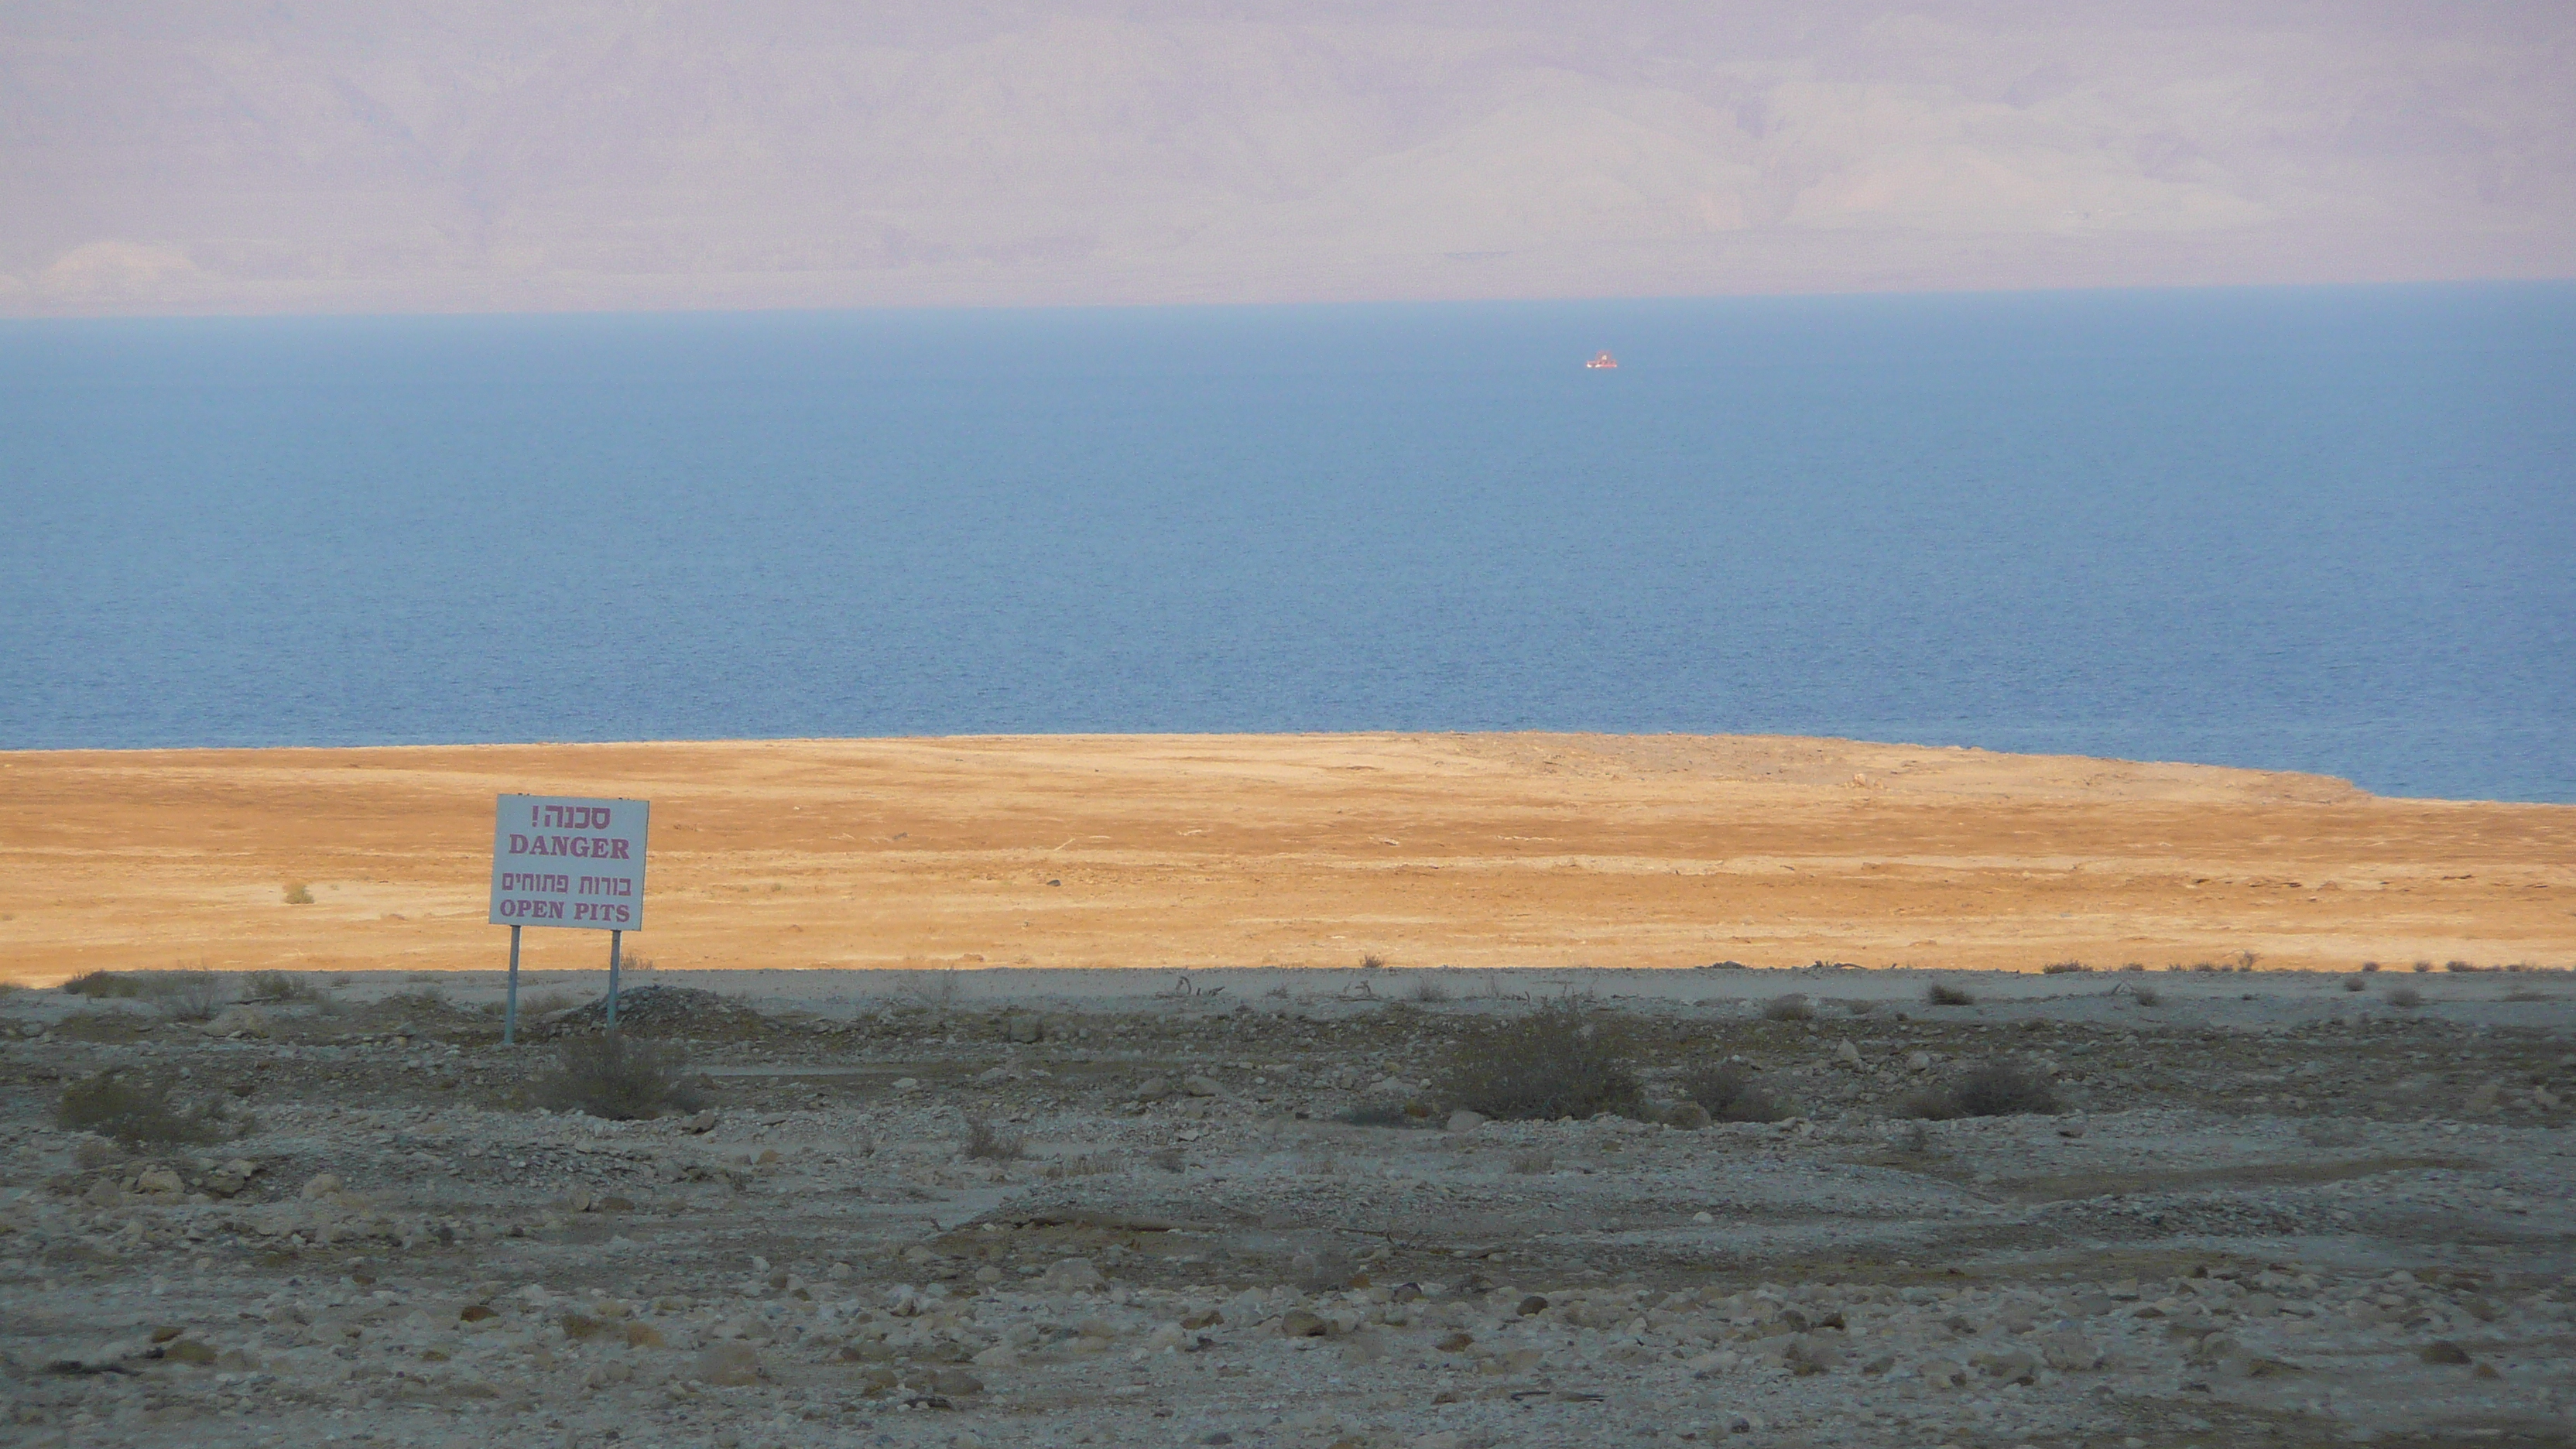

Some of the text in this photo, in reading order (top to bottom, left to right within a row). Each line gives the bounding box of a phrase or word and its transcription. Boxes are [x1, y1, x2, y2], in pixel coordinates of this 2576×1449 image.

[532, 805, 611, 829] סכנה!
[509, 834, 630, 859] DANGER
[502, 872, 632, 896] בורות פתוחים
[499, 899, 631, 922] OPEN PITS
